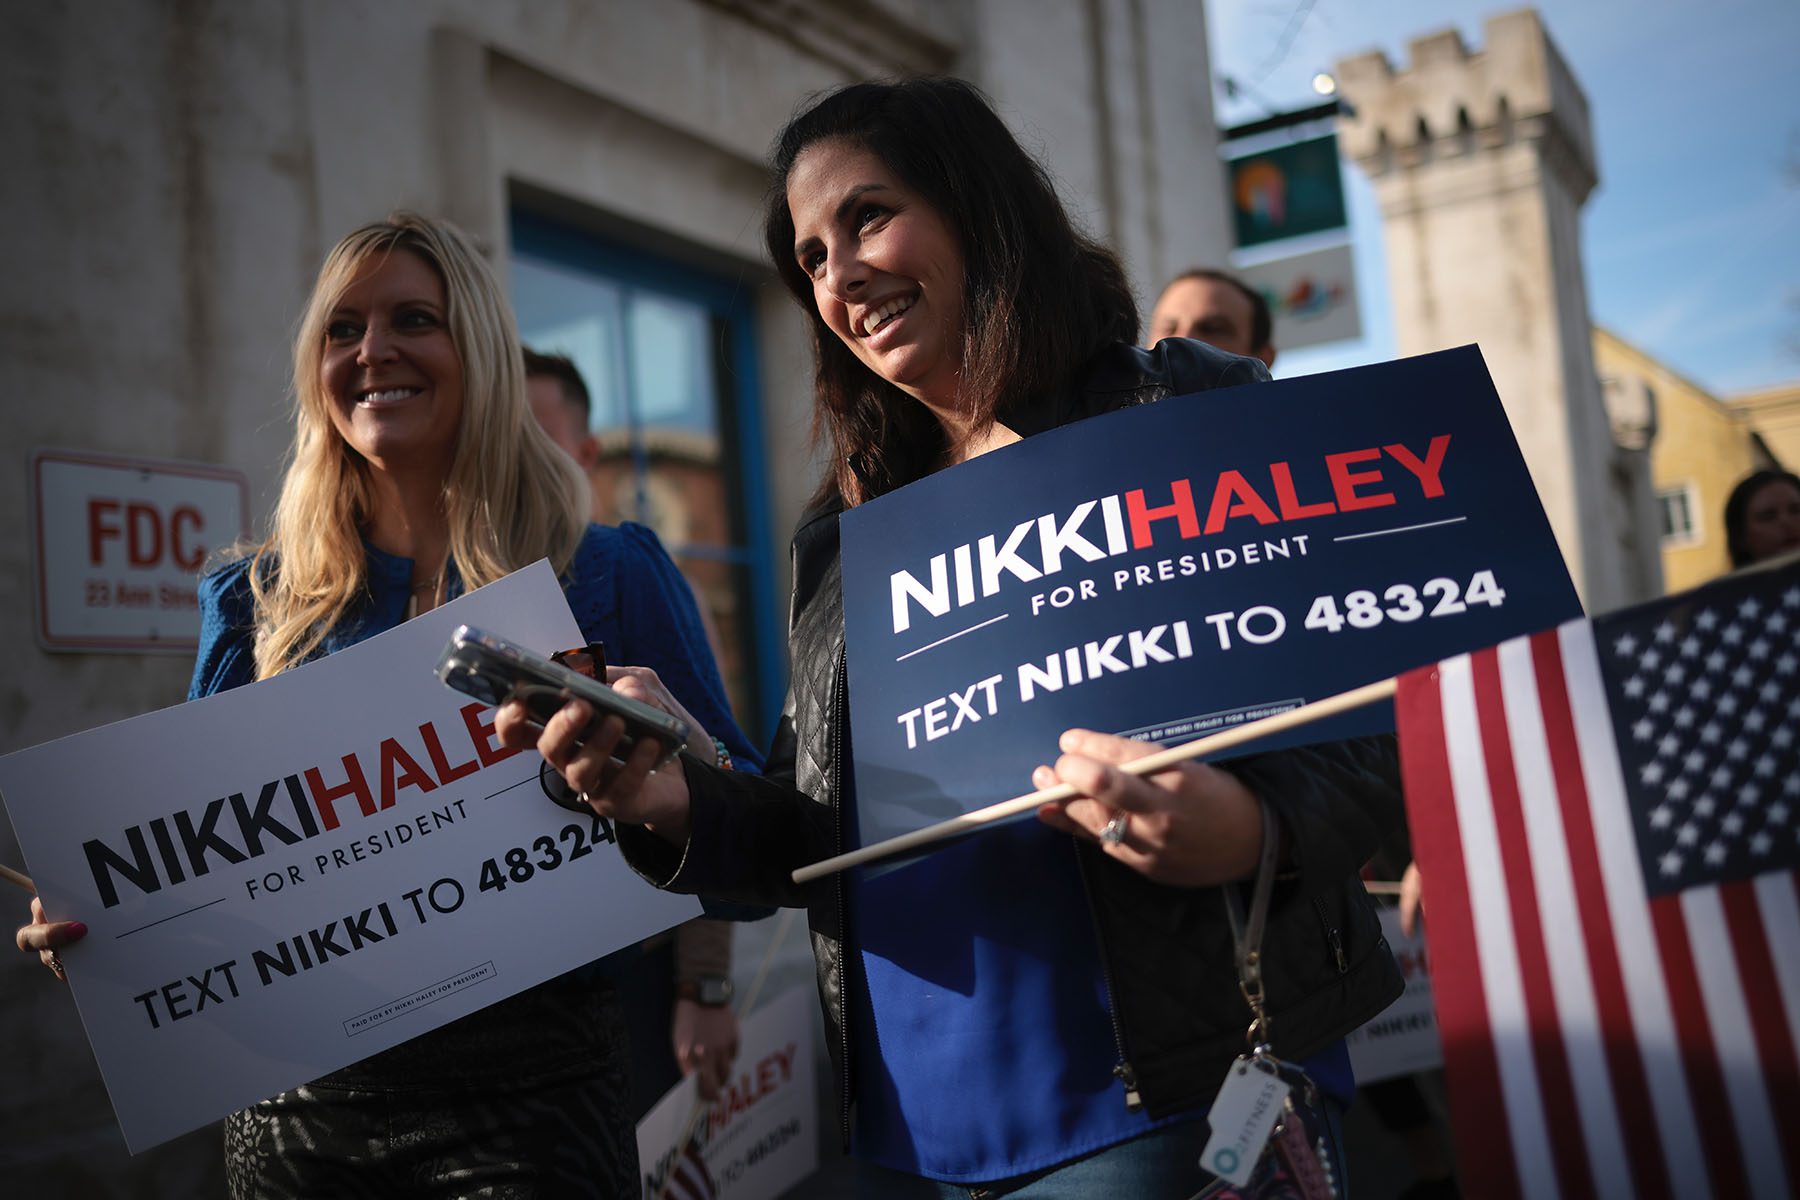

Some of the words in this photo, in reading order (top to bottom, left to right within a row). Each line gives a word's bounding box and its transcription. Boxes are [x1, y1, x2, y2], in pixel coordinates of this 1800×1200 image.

[87, 498, 206, 573] FDC
[1031, 579, 1098, 616] FOR
[1114, 534, 1309, 591] PRESIDENT
[897, 673, 1003, 750] TEXT
[1017, 620, 1193, 703] NIKKI
[1205, 605, 1287, 650] TO
[1304, 569, 1506, 633] 48324
[82, 702, 523, 909] NIKKIHALE
[246, 866, 304, 900] FOR
[315, 799, 468, 874] PRESIDENT
[134, 960, 240, 1029] TEXT
[252, 902, 398, 986] NIKKI
[402, 878, 464, 924] TO
[479, 815, 615, 893] 48324
[351, 1018, 368, 1029] PAID
[370, 1012, 383, 1022] FOR
[384, 1007, 393, 1016] BY
[394, 1000, 415, 1011] NIKKI
[416, 990, 437, 1003] HALEY
[439, 983, 452, 993] FOR
[453, 968, 488, 987] PRESIDENT
